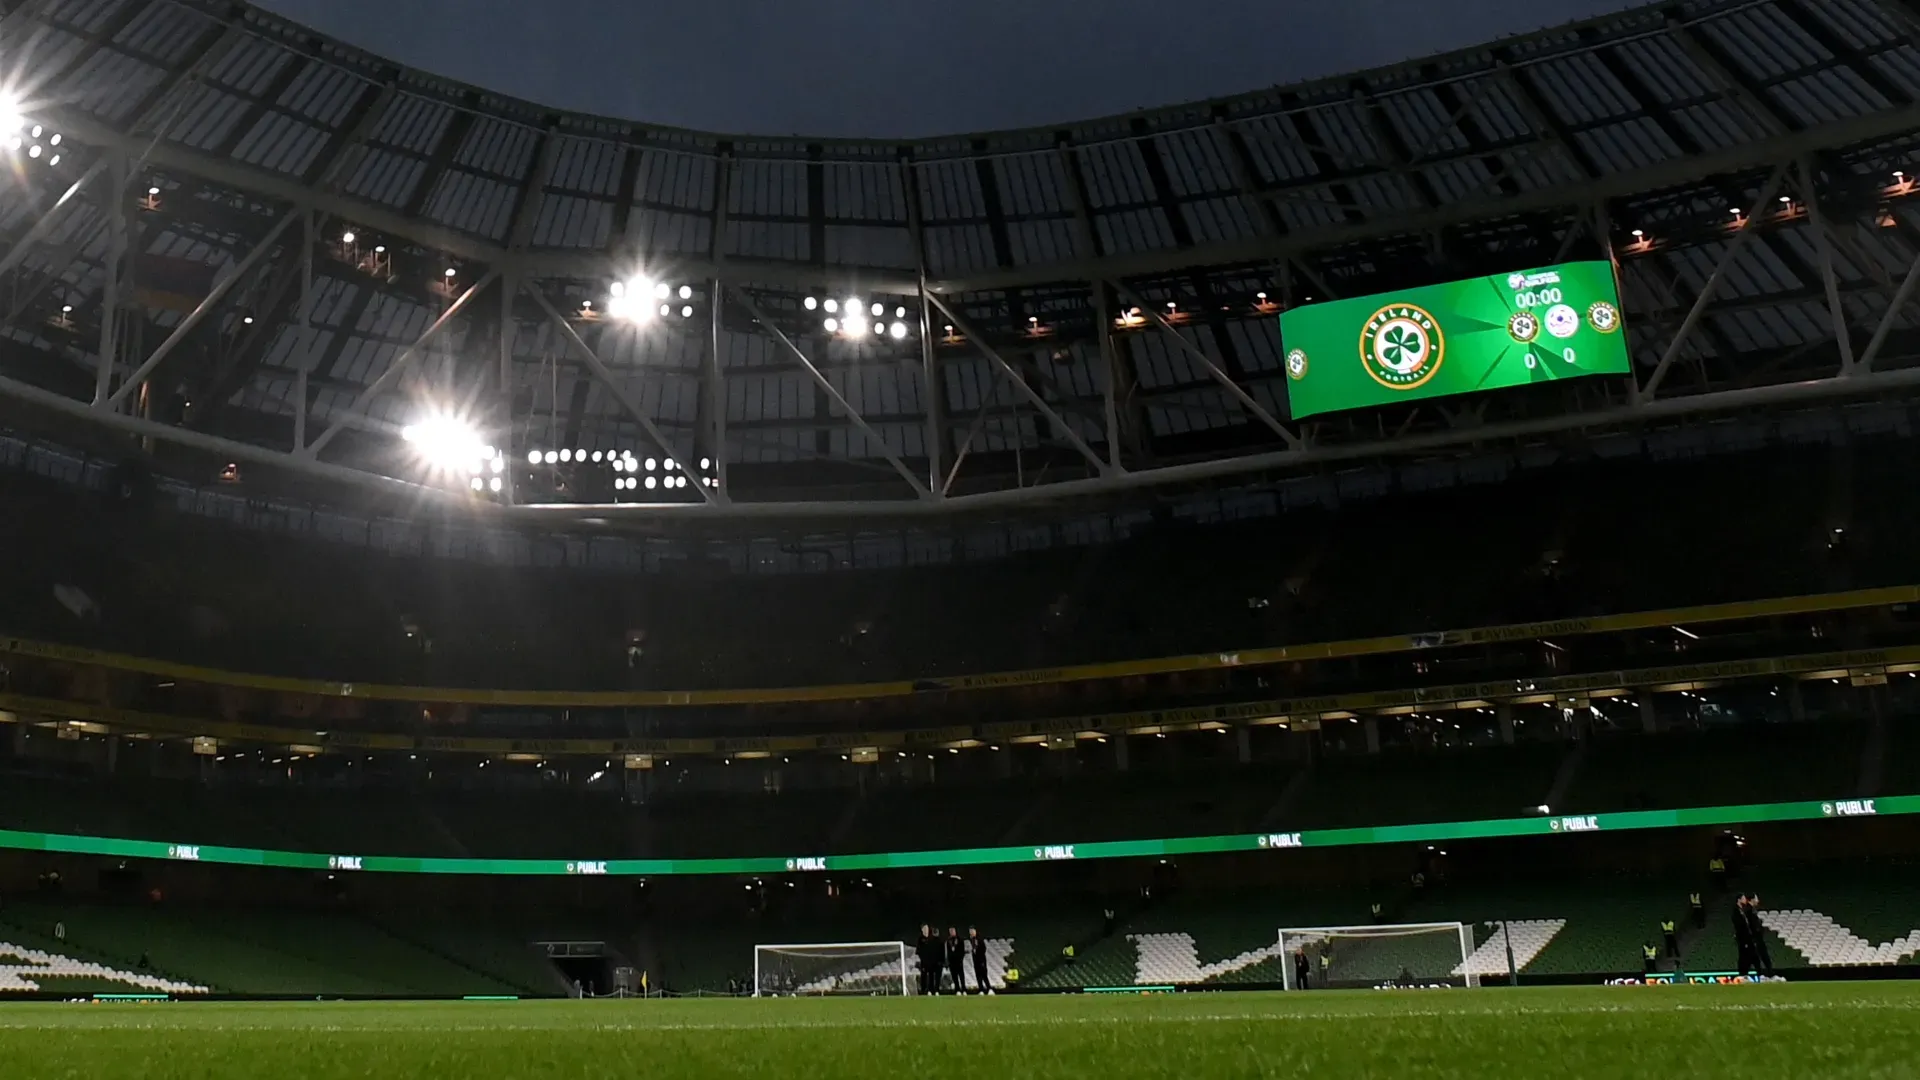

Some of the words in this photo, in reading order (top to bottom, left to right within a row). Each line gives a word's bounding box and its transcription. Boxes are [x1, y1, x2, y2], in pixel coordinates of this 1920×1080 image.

[1515, 288, 1562, 308] 00:00
[1365, 308, 1432, 338] IRELAND
[1524, 353, 1536, 369] 0
[1563, 347, 1575, 363] 0
[1835, 799, 1876, 816] PUBLIC
[1562, 816, 1599, 831] PUBLIC
[1269, 833, 1302, 848] PUBLIC
[176, 845, 200, 860] PUBLIC
[1045, 845, 1075, 859] PUBLIC
[337, 856, 362, 870] PUBLIC
[577, 861, 607, 874] PUBLIC
[797, 857, 826, 871] PUBLIC
